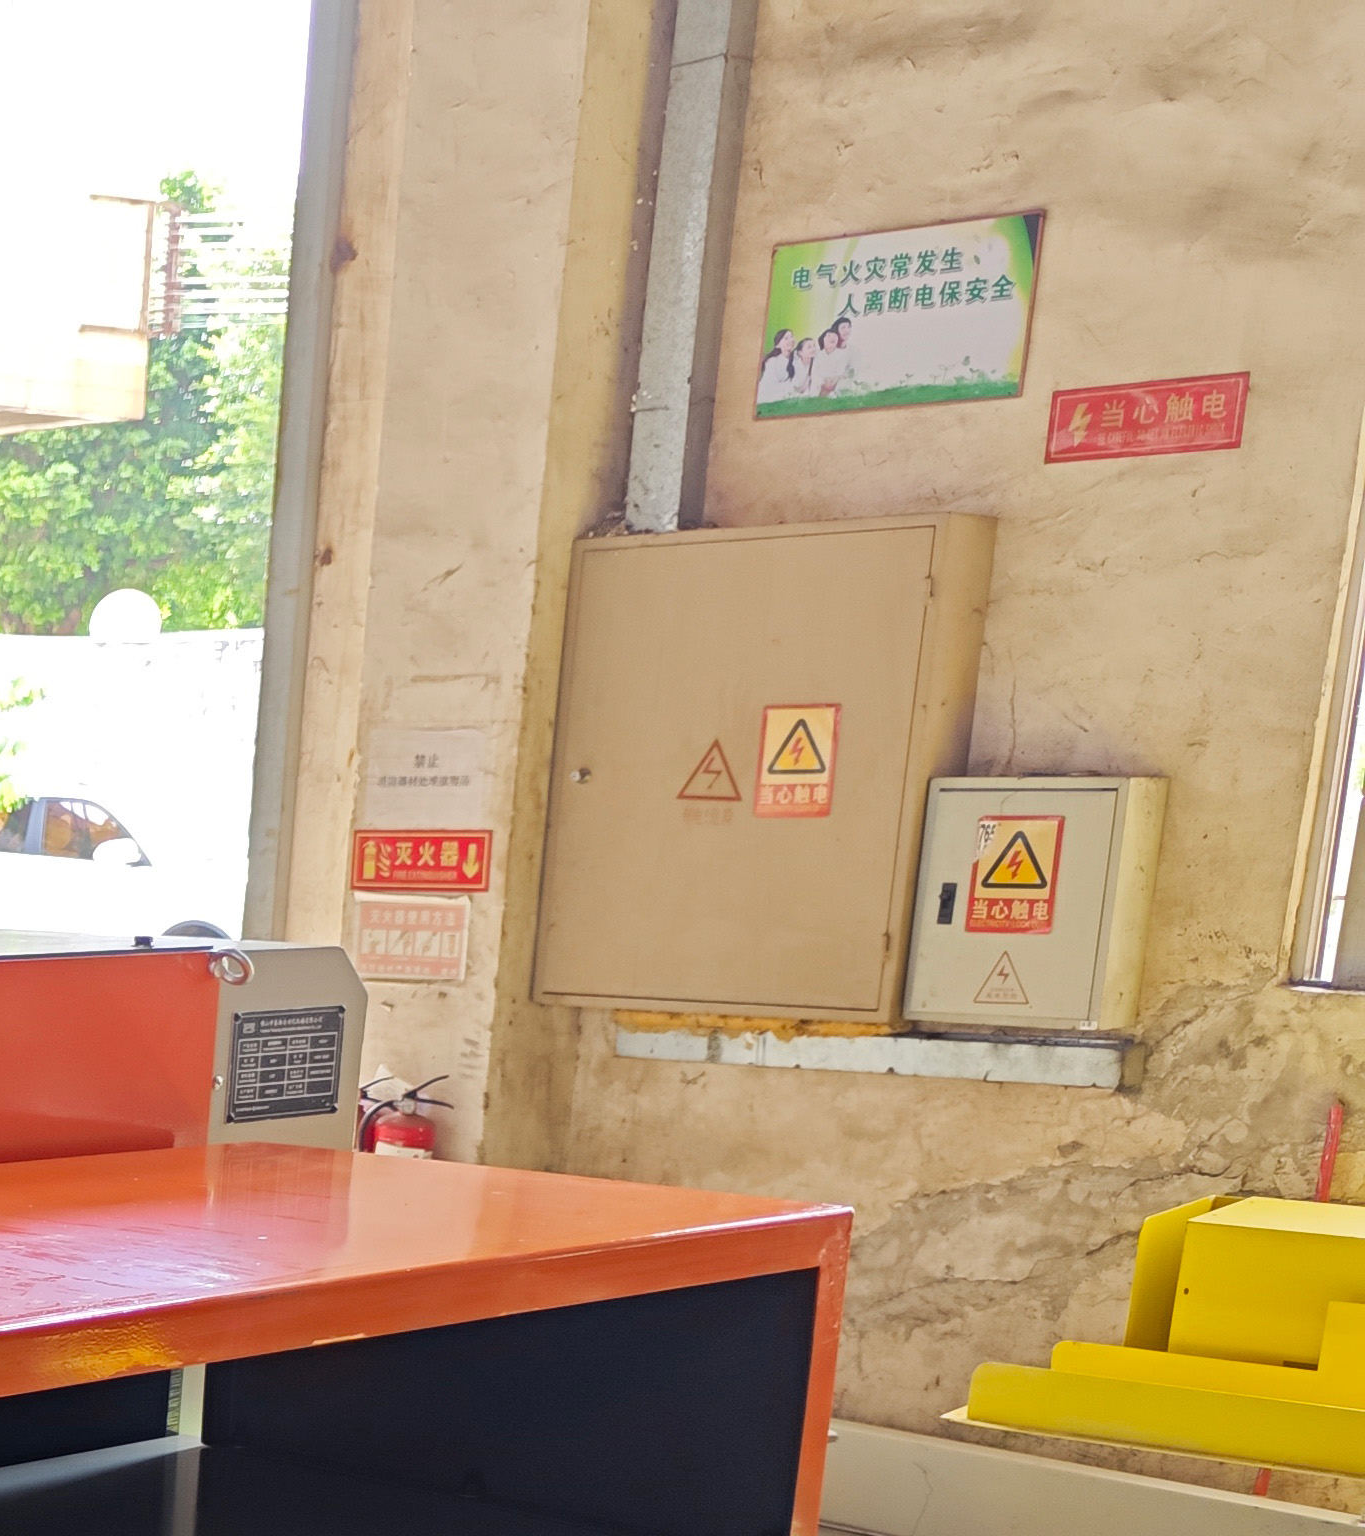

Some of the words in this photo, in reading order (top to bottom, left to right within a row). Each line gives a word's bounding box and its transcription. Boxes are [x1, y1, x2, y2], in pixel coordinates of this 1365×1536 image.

[791, 246, 965, 291] 电气火灾常发生
[837, 274, 1016, 317] 人离断电保安全
[1100, 388, 1228, 428] 当心触电
[759, 783, 828, 806] 当心触电
[393, 840, 459, 867] 灭火器
[971, 899, 1049, 920] 当心触电
